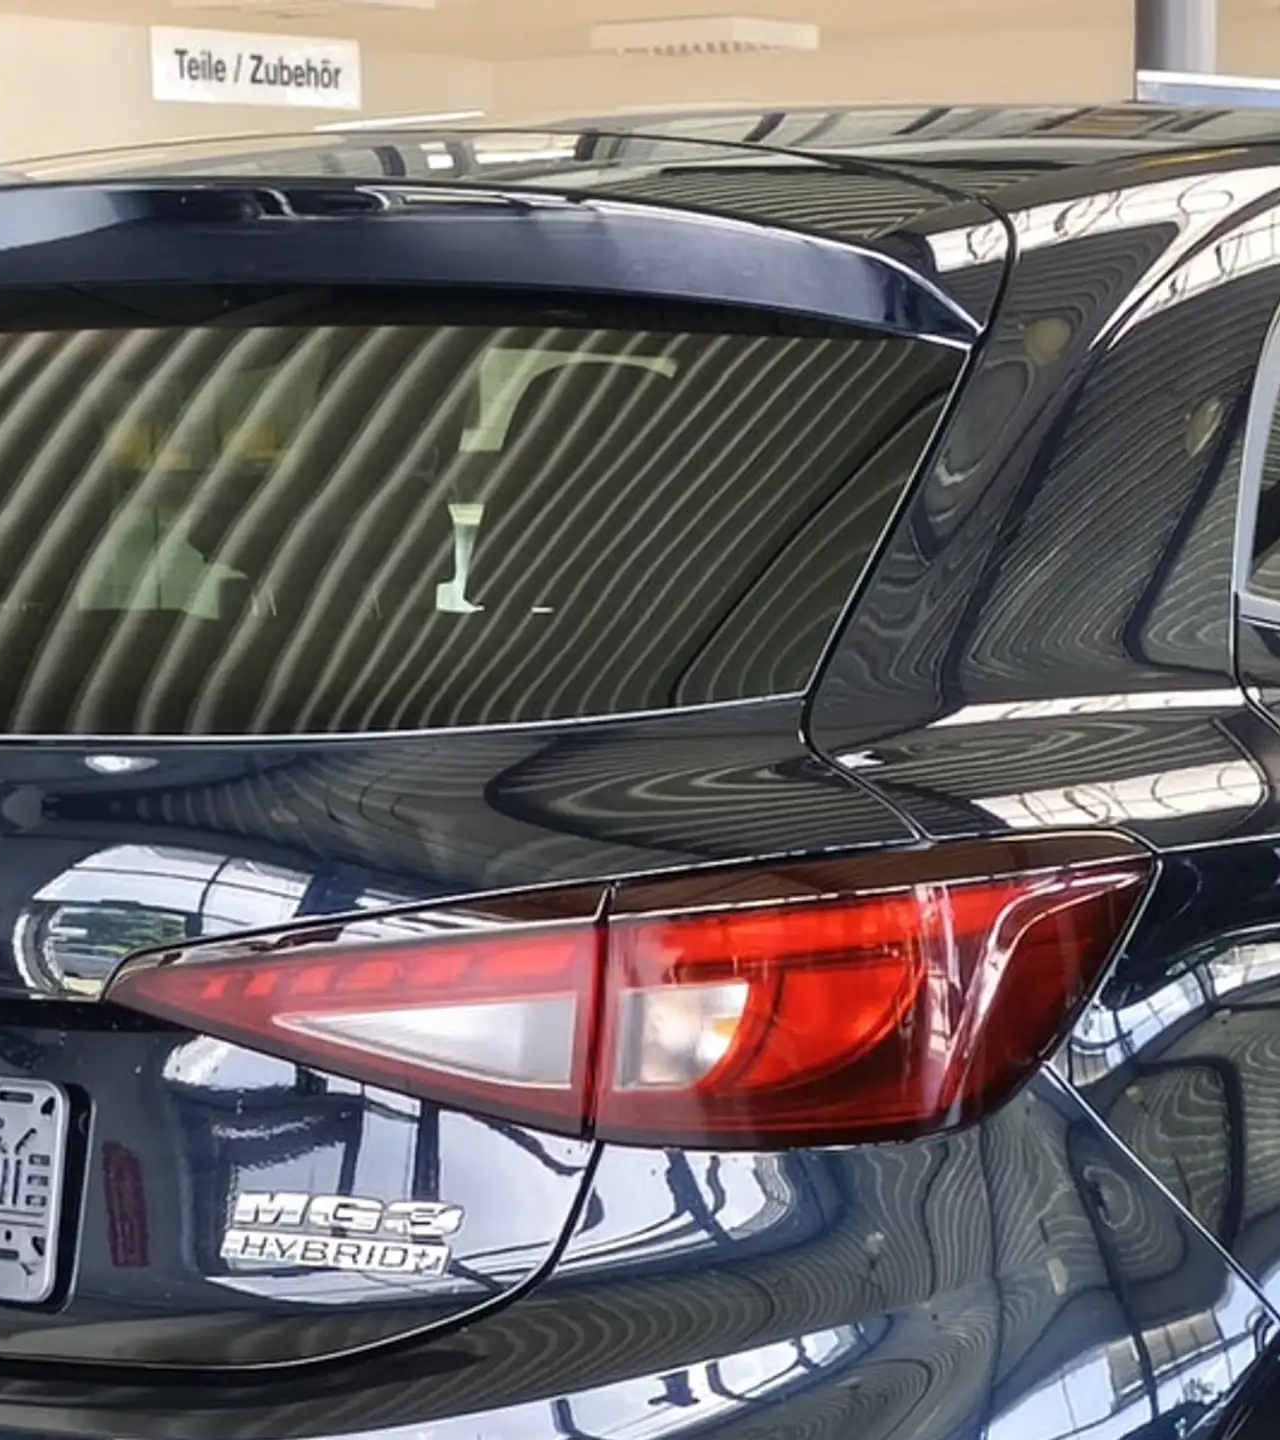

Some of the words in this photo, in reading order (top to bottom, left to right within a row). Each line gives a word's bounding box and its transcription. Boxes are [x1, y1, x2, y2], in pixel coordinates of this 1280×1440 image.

[174, 48, 227, 83] Teile
[233, 53, 242, 84] /
[249, 54, 343, 89] Zubehör
[231, 1191, 465, 1241] MG3
